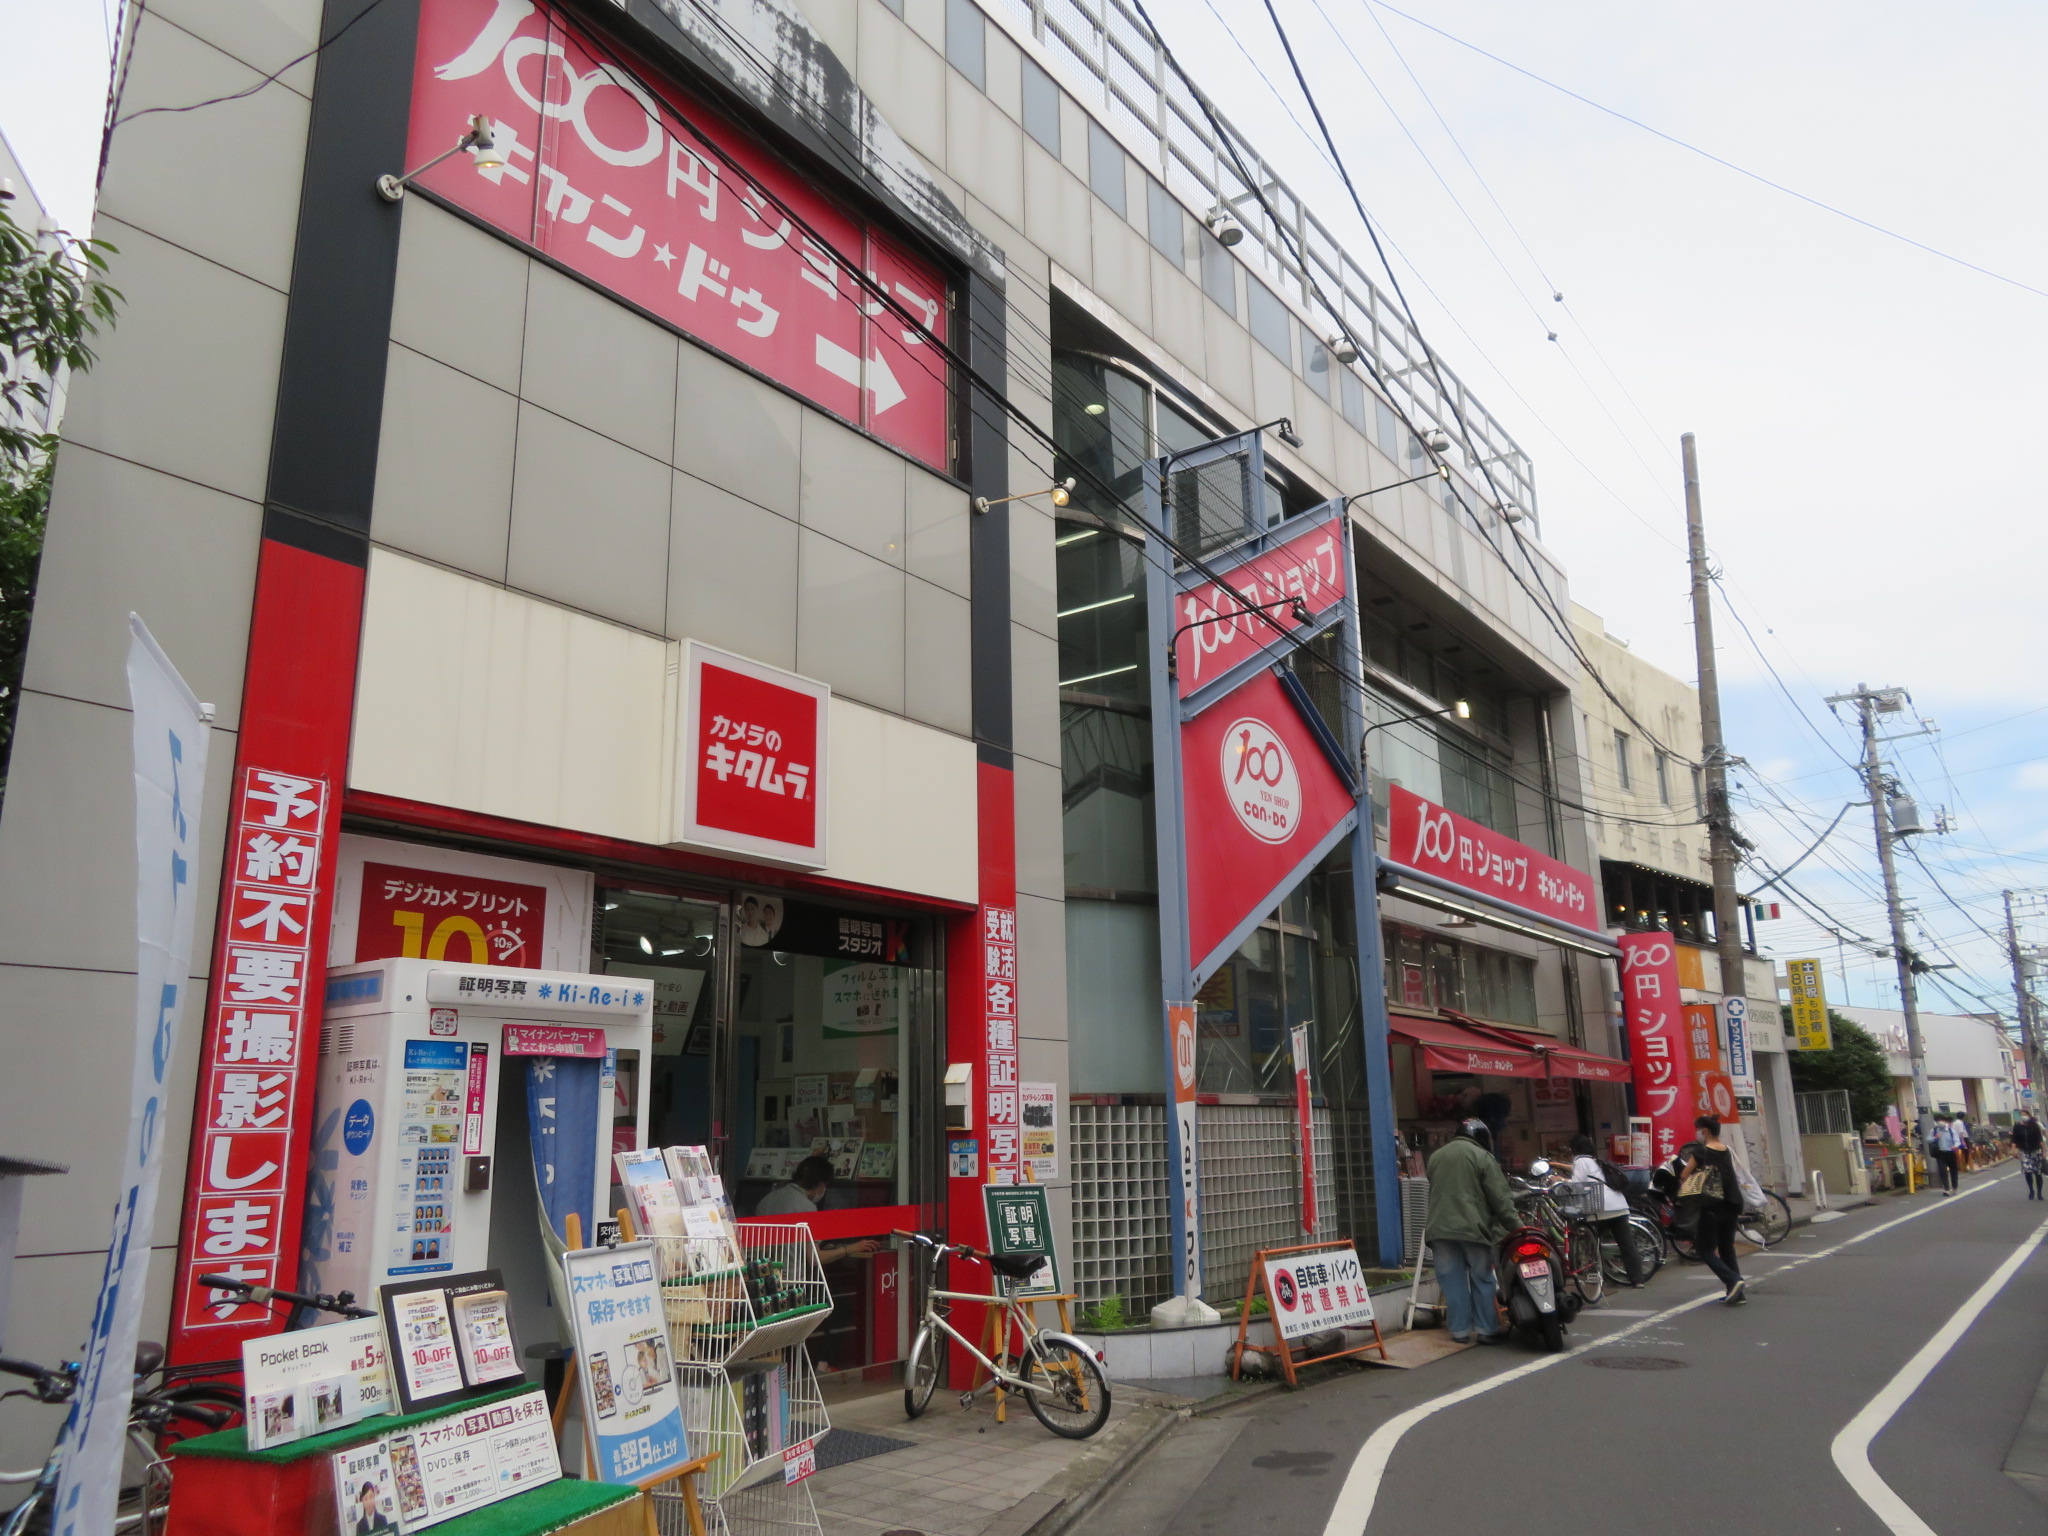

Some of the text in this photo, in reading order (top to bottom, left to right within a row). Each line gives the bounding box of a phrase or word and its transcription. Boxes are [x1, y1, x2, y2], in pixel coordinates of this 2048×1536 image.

[709, 715, 782, 753] カメラの
[705, 741, 810, 800] キタムラ
[1233, 729, 1284, 788] 100
[839, 918, 883, 939] 証明写真
[838, 935, 883, 956] スタジオ
[458, 976, 630, 1007] 証明写真 Ki-Re-i
[519, 1028, 596, 1043] マイナンバーカード
[348, 1114, 370, 1129] データ
[1657, 1127, 1675, 1160] キャ
[1005, 1205, 1034, 1224] 証明
[1008, 1226, 1037, 1246] 写真
[1295, 1259, 1358, 1289] 自転車・バイク
[588, 1294, 652, 1326] 保存できます
[1301, 1281, 1367, 1315] 放置禁止
[260, 1347, 299, 1368] Pocket
[412, 1346, 452, 1366] 10%OFF
[427, 1449, 472, 1473] DVDに保存
